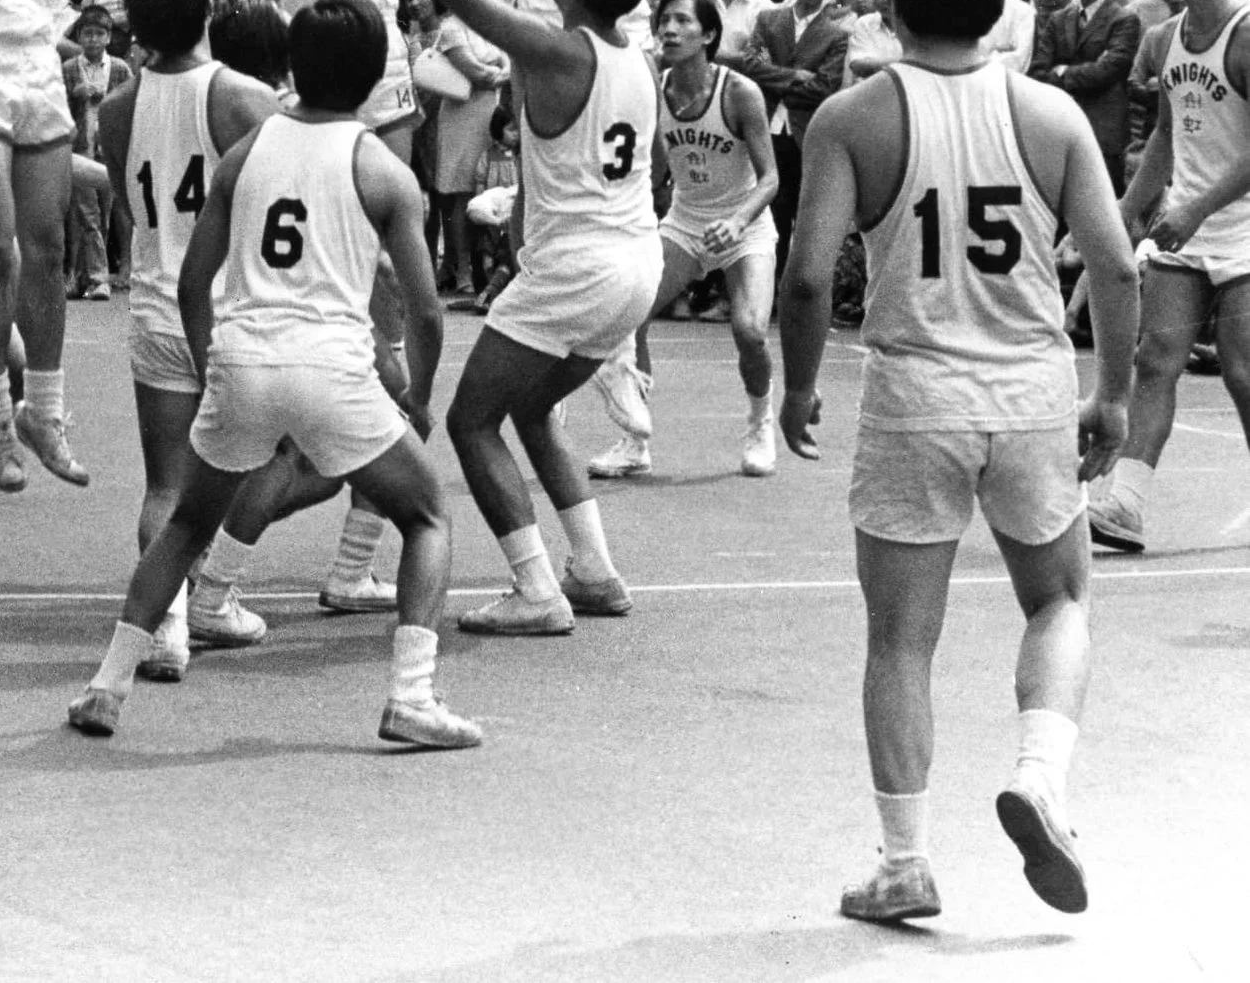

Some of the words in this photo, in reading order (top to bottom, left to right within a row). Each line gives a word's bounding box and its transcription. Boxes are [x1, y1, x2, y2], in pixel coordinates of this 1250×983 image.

[396, 88, 412, 109] 14
[1163, 62, 1228, 102] KNIGHTS
[602, 122, 637, 181] 3
[665, 128, 734, 153] NIGHTS
[136, 154, 206, 229] 14
[261, 197, 308, 269] 6
[913, 186, 1022, 279] 15
